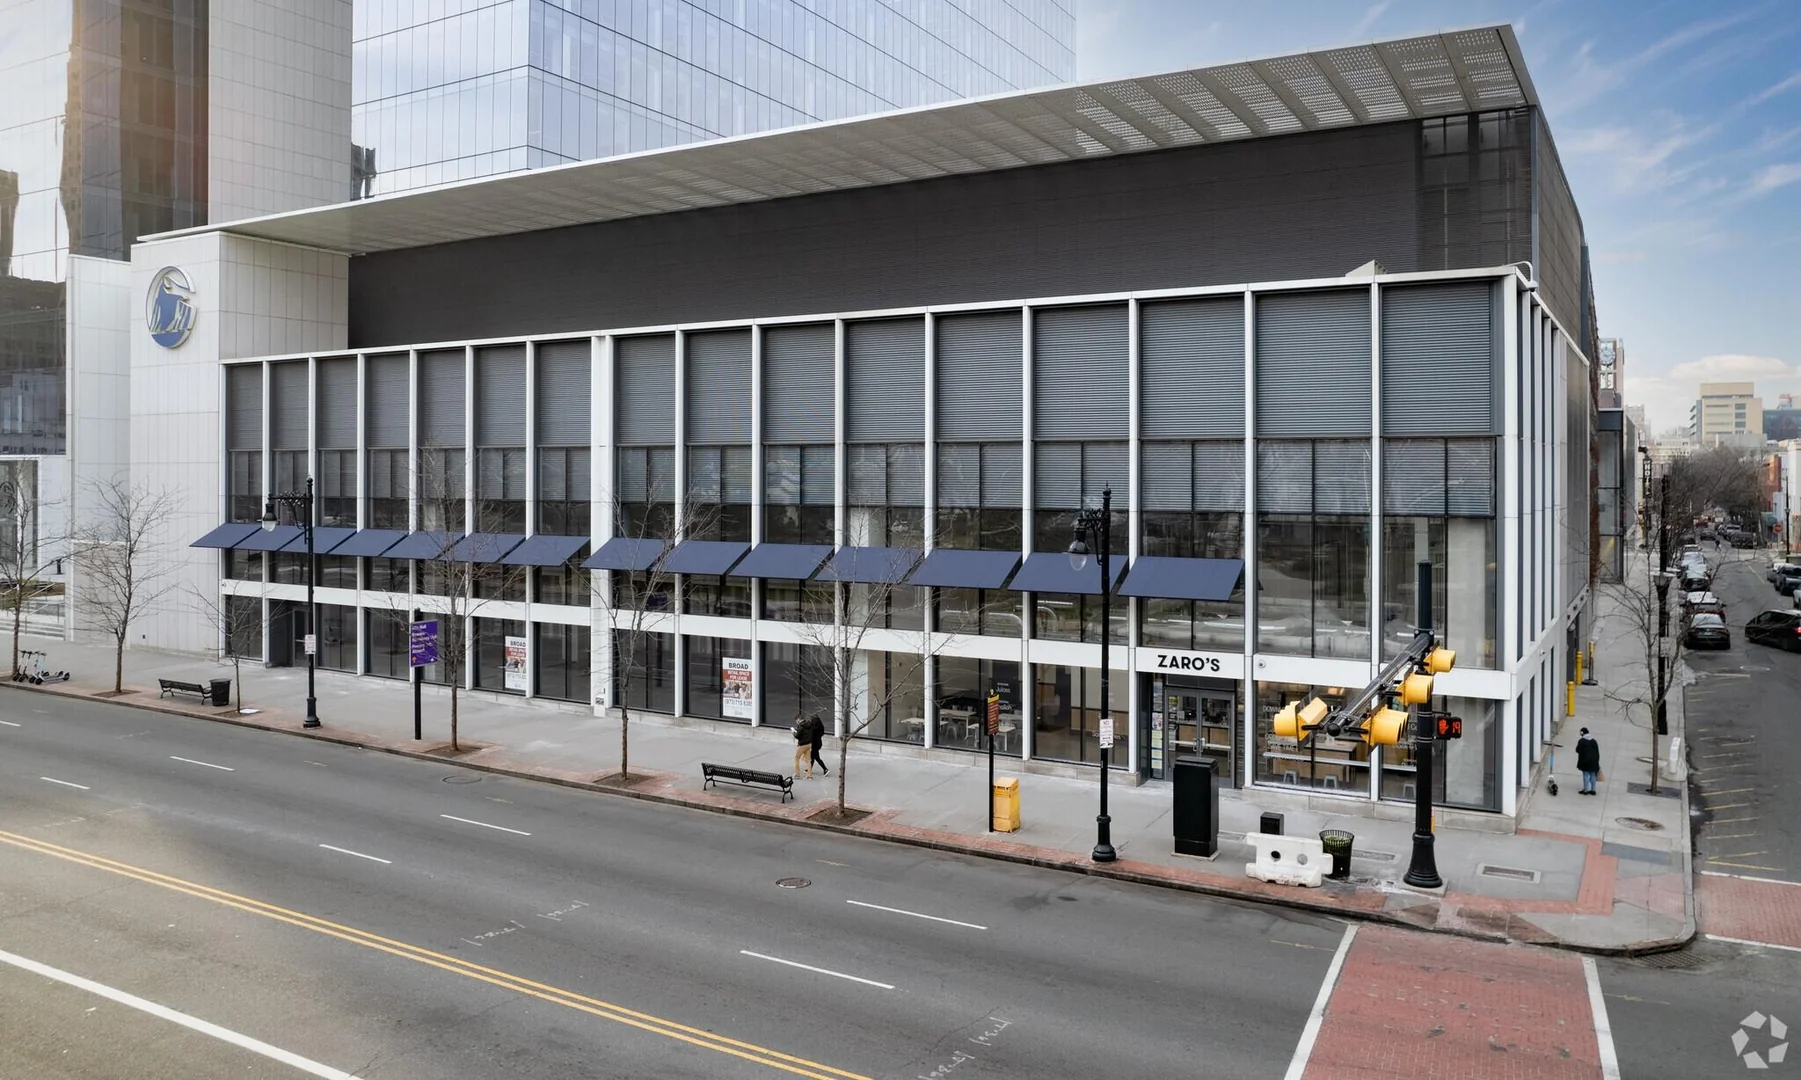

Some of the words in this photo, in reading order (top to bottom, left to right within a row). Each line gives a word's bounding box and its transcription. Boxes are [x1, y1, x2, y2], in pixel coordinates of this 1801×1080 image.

[728, 662, 749, 670] BROAD
[1157, 654, 1220, 672] ZARO'S
[1452, 721, 1461, 734] 19
